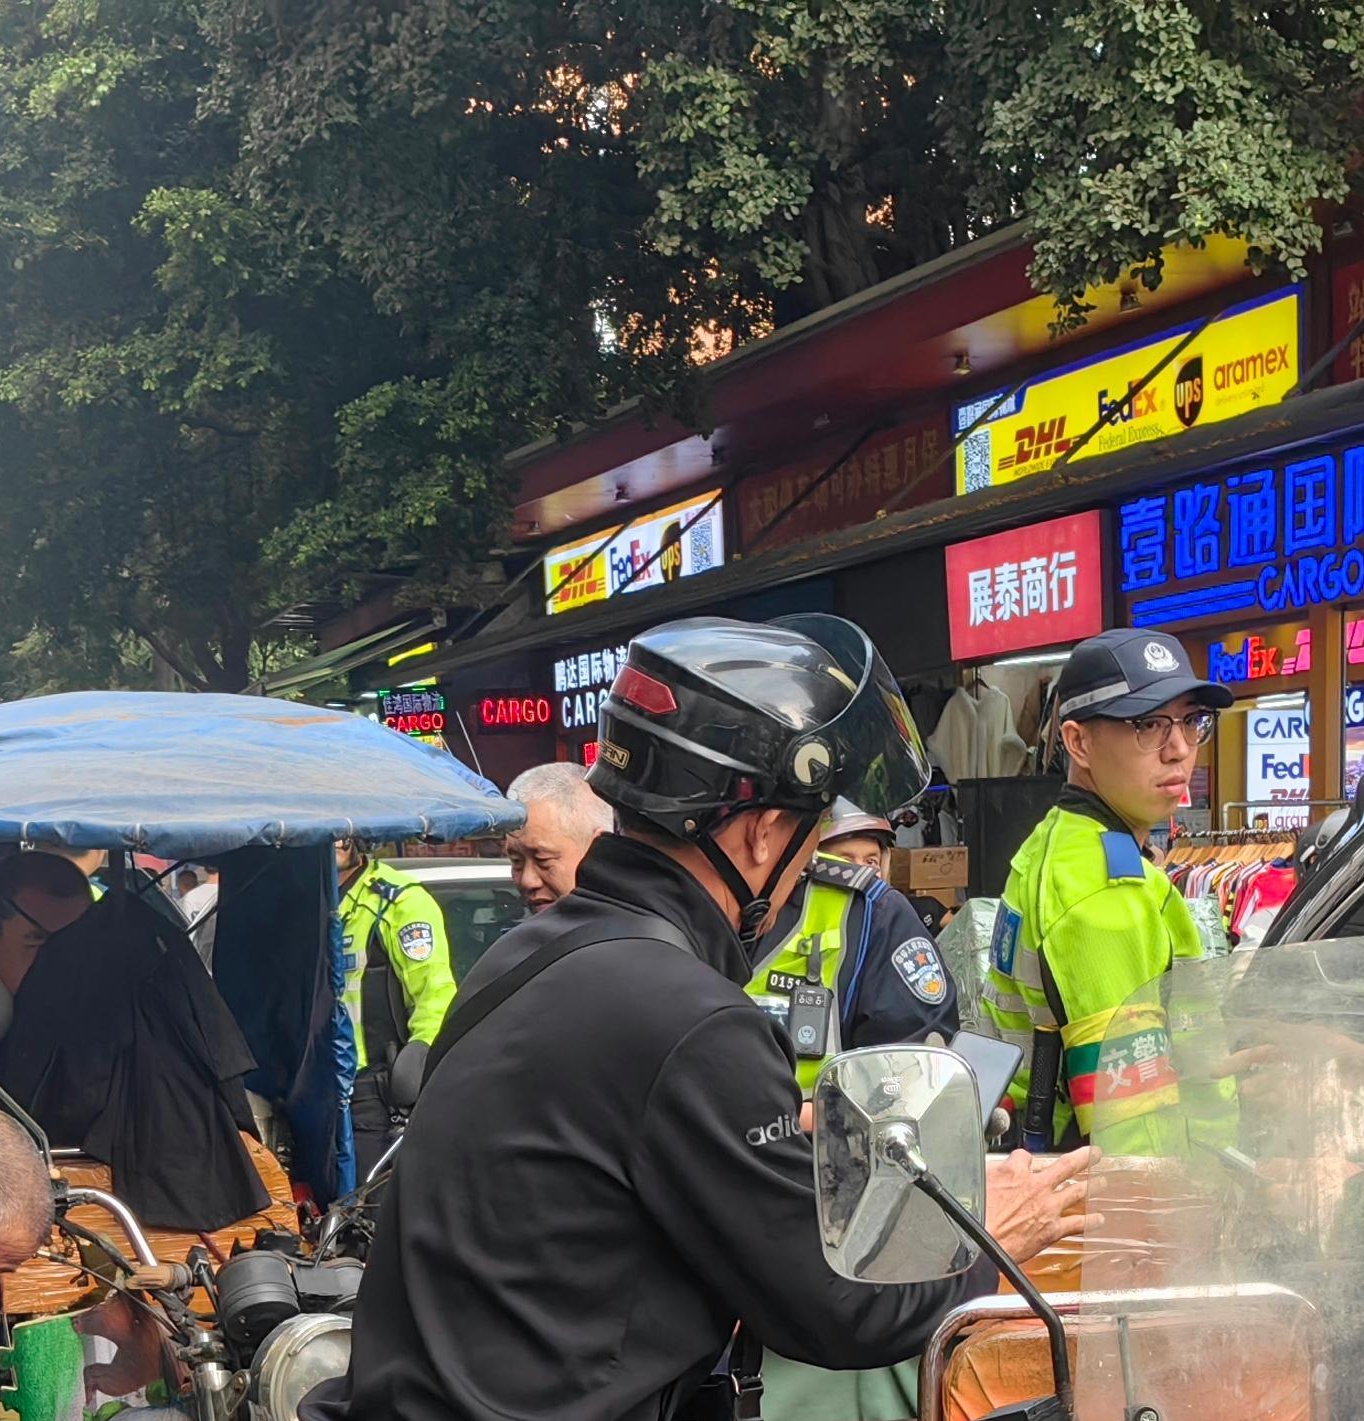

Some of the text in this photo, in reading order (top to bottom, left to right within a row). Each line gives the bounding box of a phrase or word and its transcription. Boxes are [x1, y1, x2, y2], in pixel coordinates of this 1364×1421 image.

[1213, 344, 1290, 391] aramex
[1098, 378, 1158, 426] FedEx
[1176, 376, 1202, 419] ups
[1015, 415, 1072, 465] DHL
[968, 550, 1077, 627] 展泰商行
[1208, 636, 1277, 683] FedEx
[384, 713, 444, 733] CARGO
[484, 698, 551, 724] CARGO
[1261, 753, 1310, 779] Fed
